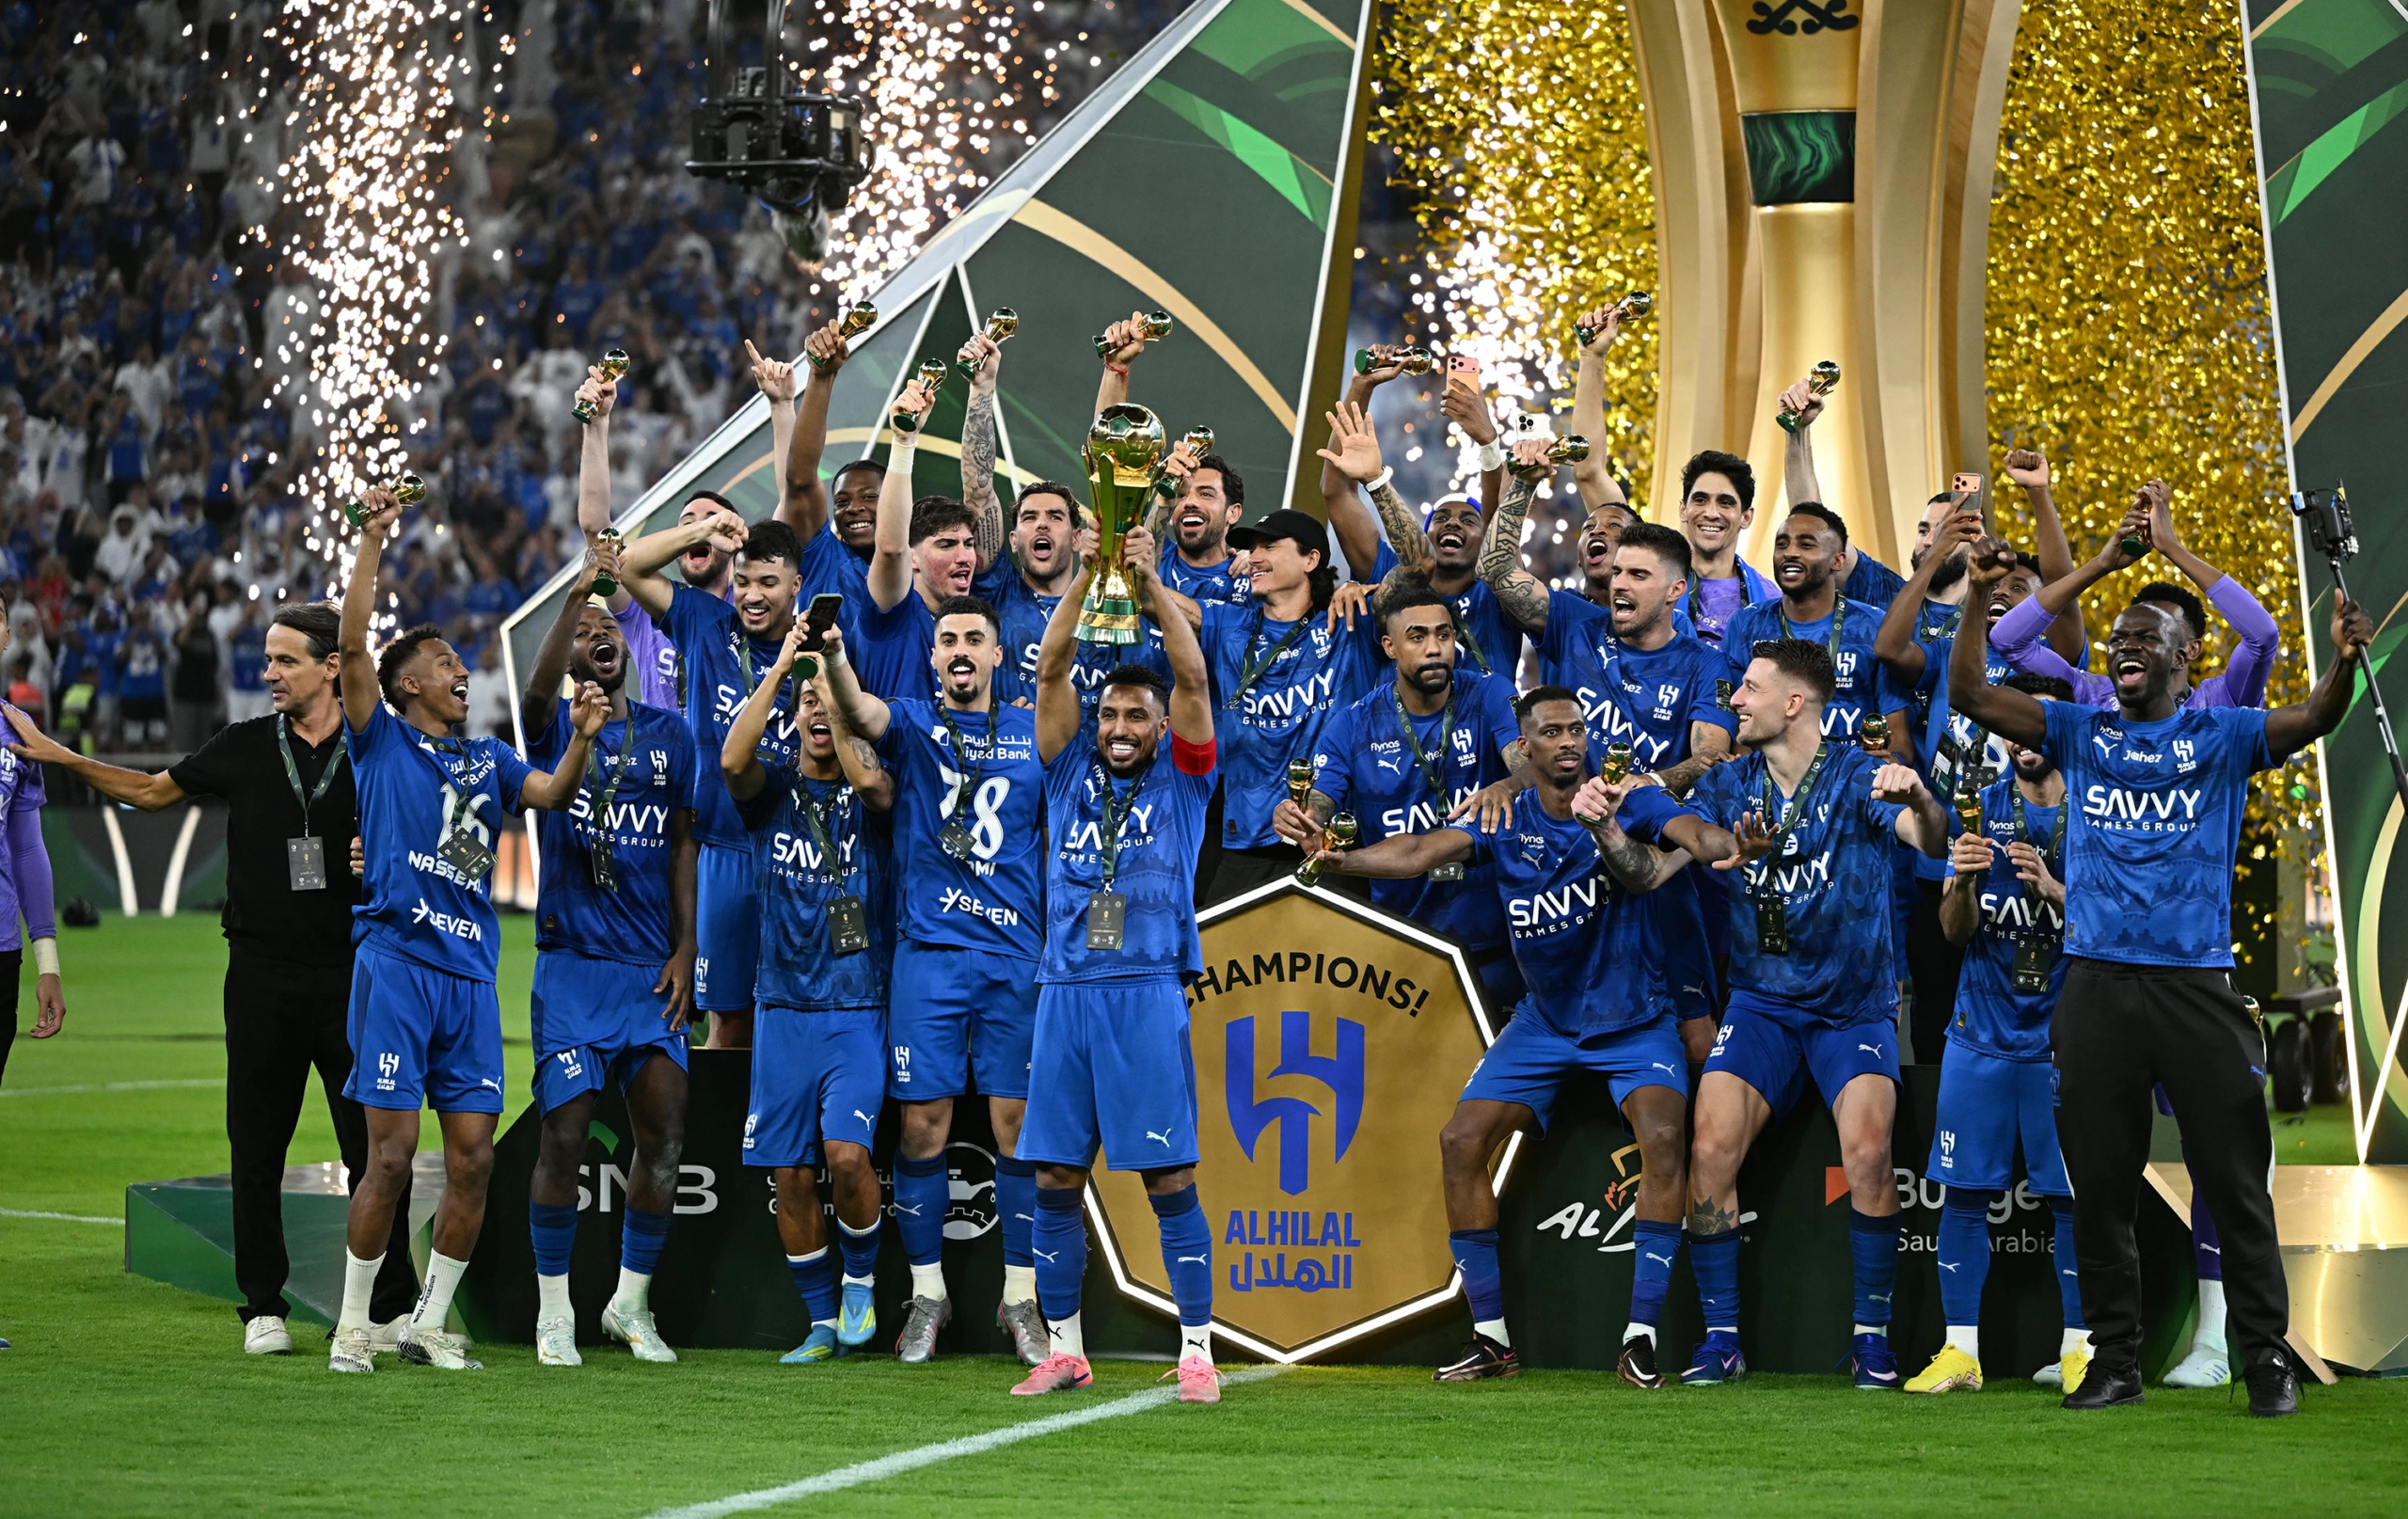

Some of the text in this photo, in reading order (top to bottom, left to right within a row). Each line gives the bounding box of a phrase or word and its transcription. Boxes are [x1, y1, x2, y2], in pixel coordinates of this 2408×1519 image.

[1275, 647, 1302, 663] Jahe
[1243, 669, 1333, 717] SAVVY
[1576, 687, 1670, 764] SAVVY
[1585, 725, 1609, 745] MES
[955, 746, 1031, 761] iyad Bank
[1370, 739, 1401, 752] flynas
[2123, 750, 2162, 763] Jahez
[468, 759, 497, 785] Bank
[2083, 784, 2201, 820] SAVVY
[621, 835, 665, 847] GROUP
[1065, 804, 1153, 851] SAY
[2142, 822, 2196, 832] GROUP
[772, 831, 856, 869] SAVY
[1059, 835, 1154, 864] GAME ROUP
[1509, 874, 1611, 926] SAVVY
[1980, 893, 2064, 930] SAVV
[429, 909, 482, 941] SEVEN
[1515, 921, 1569, 939] GAMES
[1225, 1210, 1361, 1248] ALHILAL
[1897, 1227, 1939, 1252] Sau
[1229, 1252, 1352, 1293] الهلال
